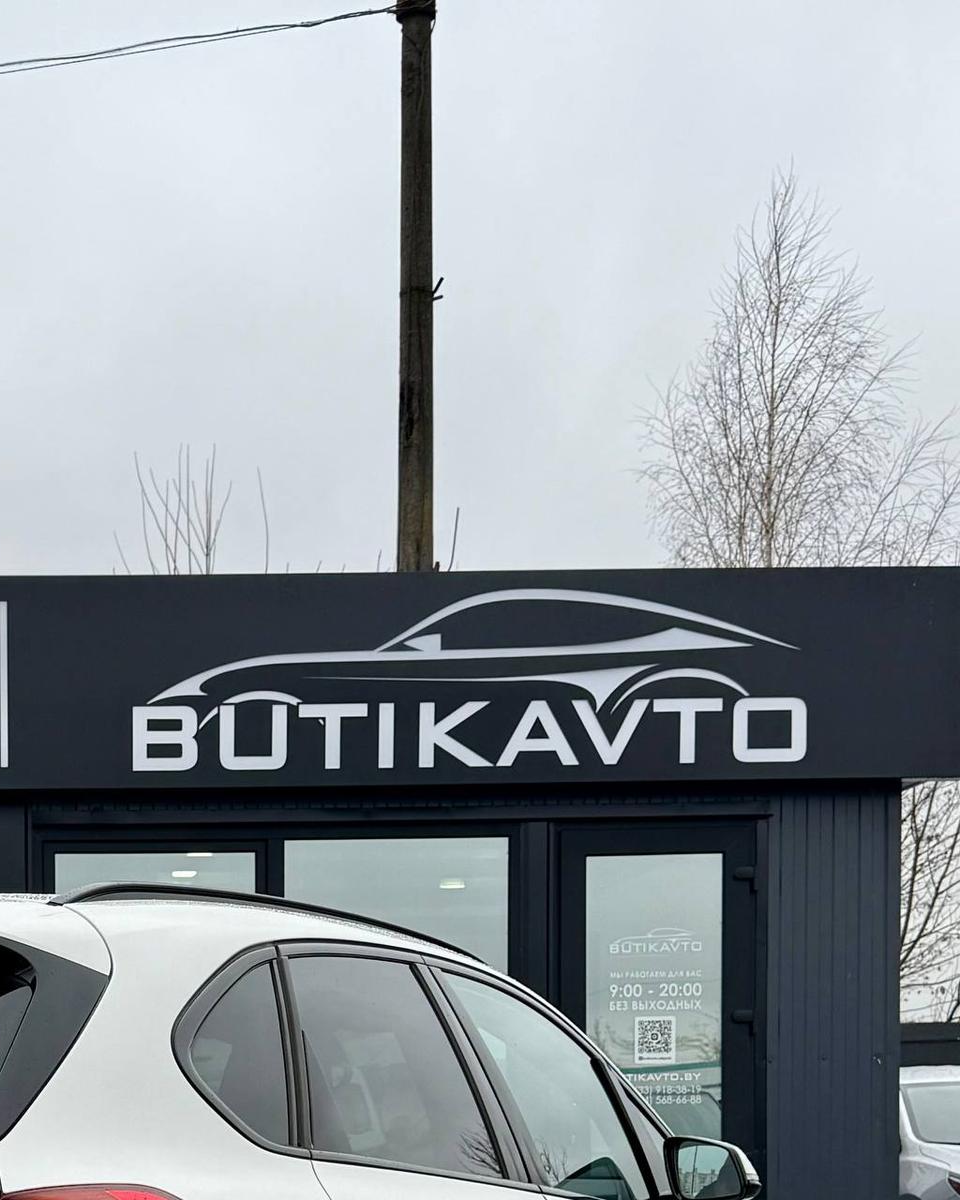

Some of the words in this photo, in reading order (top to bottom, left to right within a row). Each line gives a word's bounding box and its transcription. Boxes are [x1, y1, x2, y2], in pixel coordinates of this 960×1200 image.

[132, 697, 808, 771] BUTIKAVTO
[609, 941, 702, 953] BUTIKAVTO
[609, 984, 642, 997] 9:00
[659, 983, 702, 996] 20:00
[609, 1001, 628, 1011] БЕЗ
[631, 1000, 702, 1011] ВЫХОДНЫХ
[625, 1073, 702, 1081] TIKAVTO.BY
[655, 1084, 702, 1095] 918-38-19
[655, 1095, 702, 1105] 568-66-88
